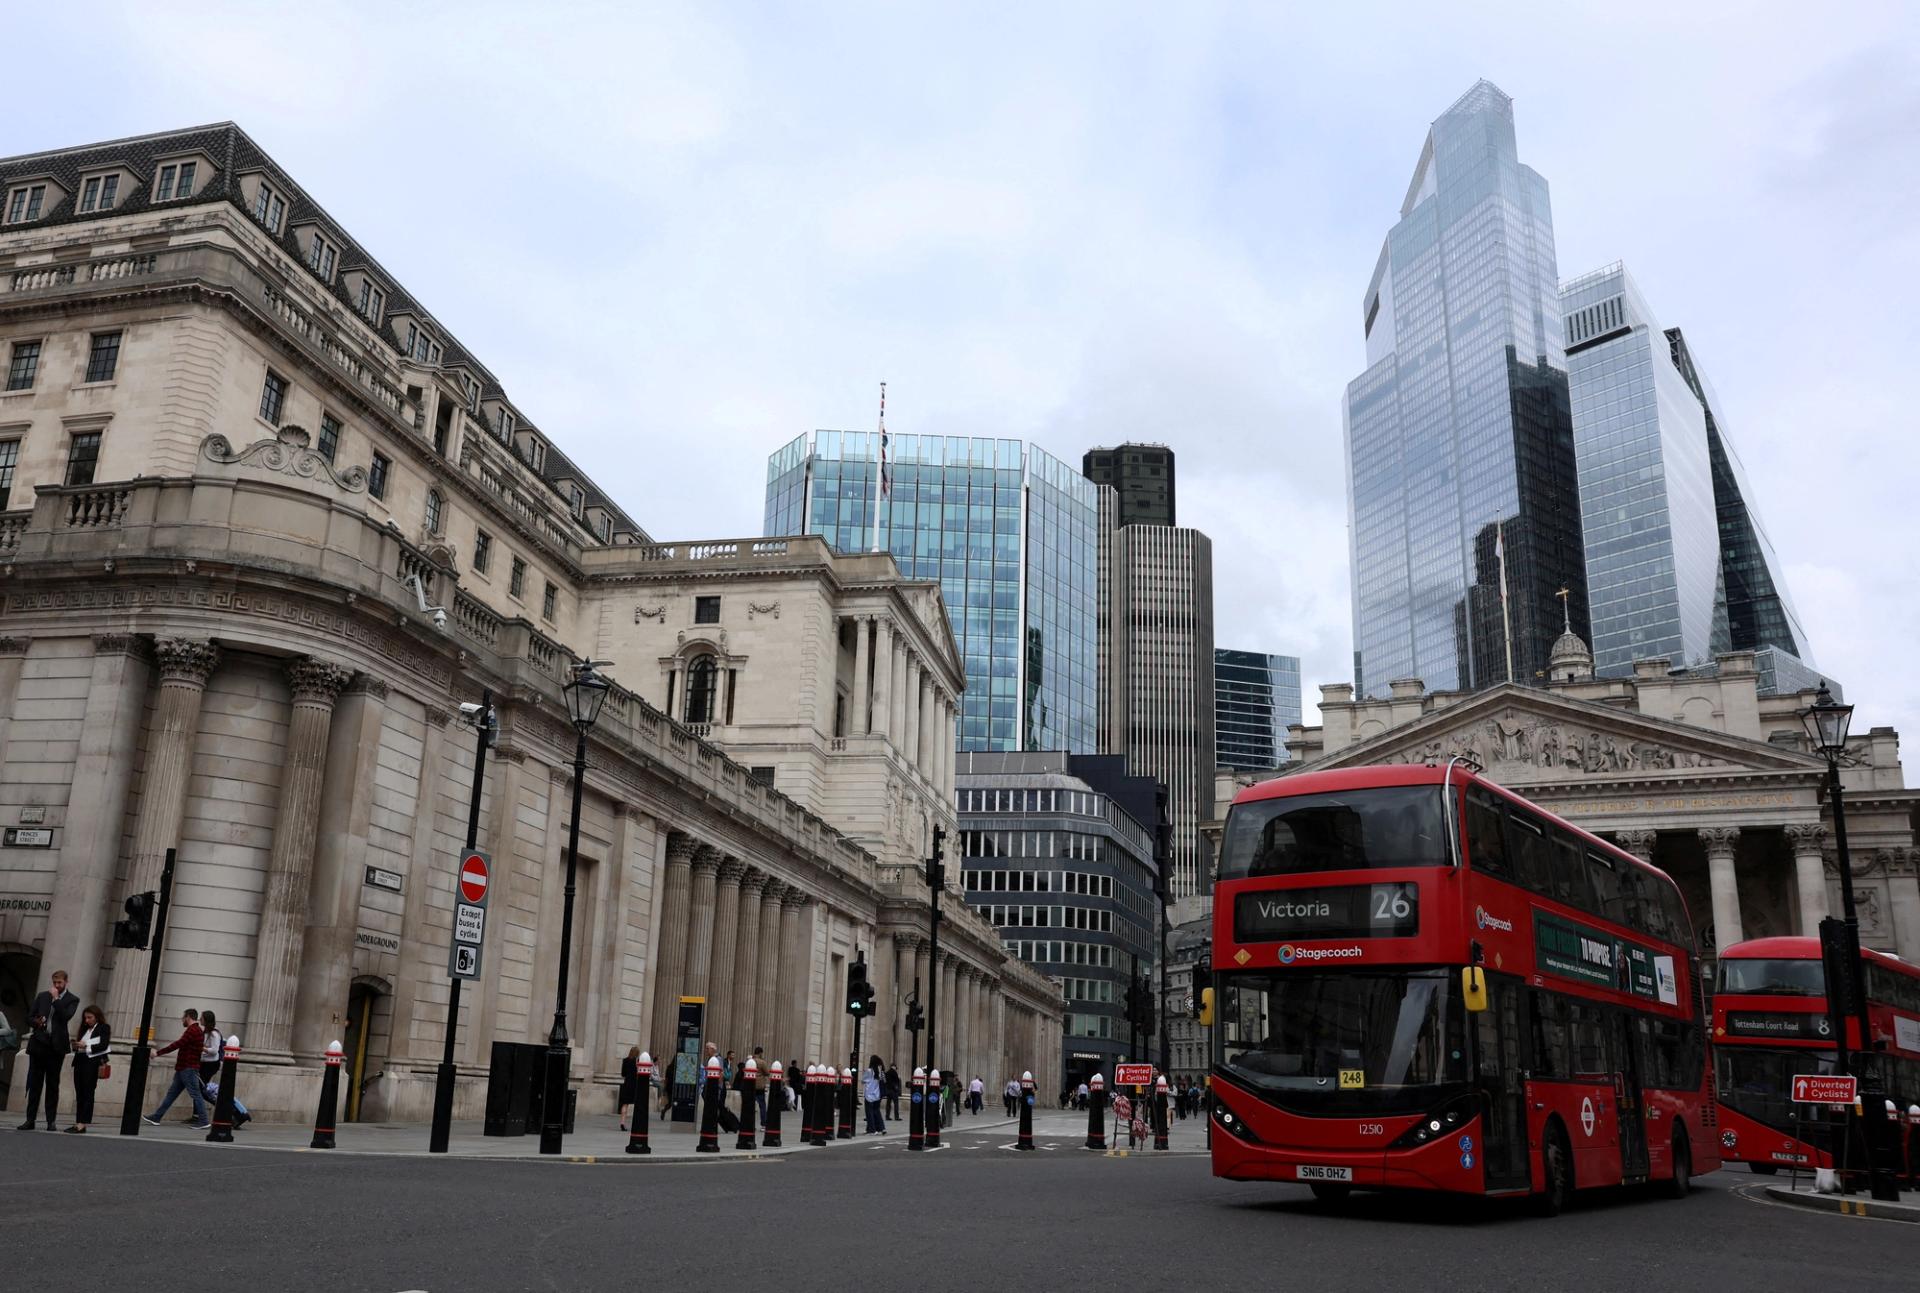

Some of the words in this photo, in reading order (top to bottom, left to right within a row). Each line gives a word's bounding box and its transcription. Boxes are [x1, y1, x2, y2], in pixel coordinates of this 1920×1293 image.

[1258, 901, 1330, 919] Victoria
[1375, 891, 1410, 919] 26
[461, 908, 480, 919] Except
[458, 919, 475, 928] buses
[1484, 912, 1512, 932] Stagecoach
[459, 929, 478, 939] cycles
[1295, 946, 1362, 960] Stagecoach
[1819, 1019, 1830, 1035] 8
[1343, 1072, 1361, 1083] 248
[1811, 1080, 1850, 1088] Diverted
[1811, 1089, 1849, 1099] Cyclists
[1360, 1124, 1383, 1135] 12510
[1302, 1167, 1324, 1177] SN16
